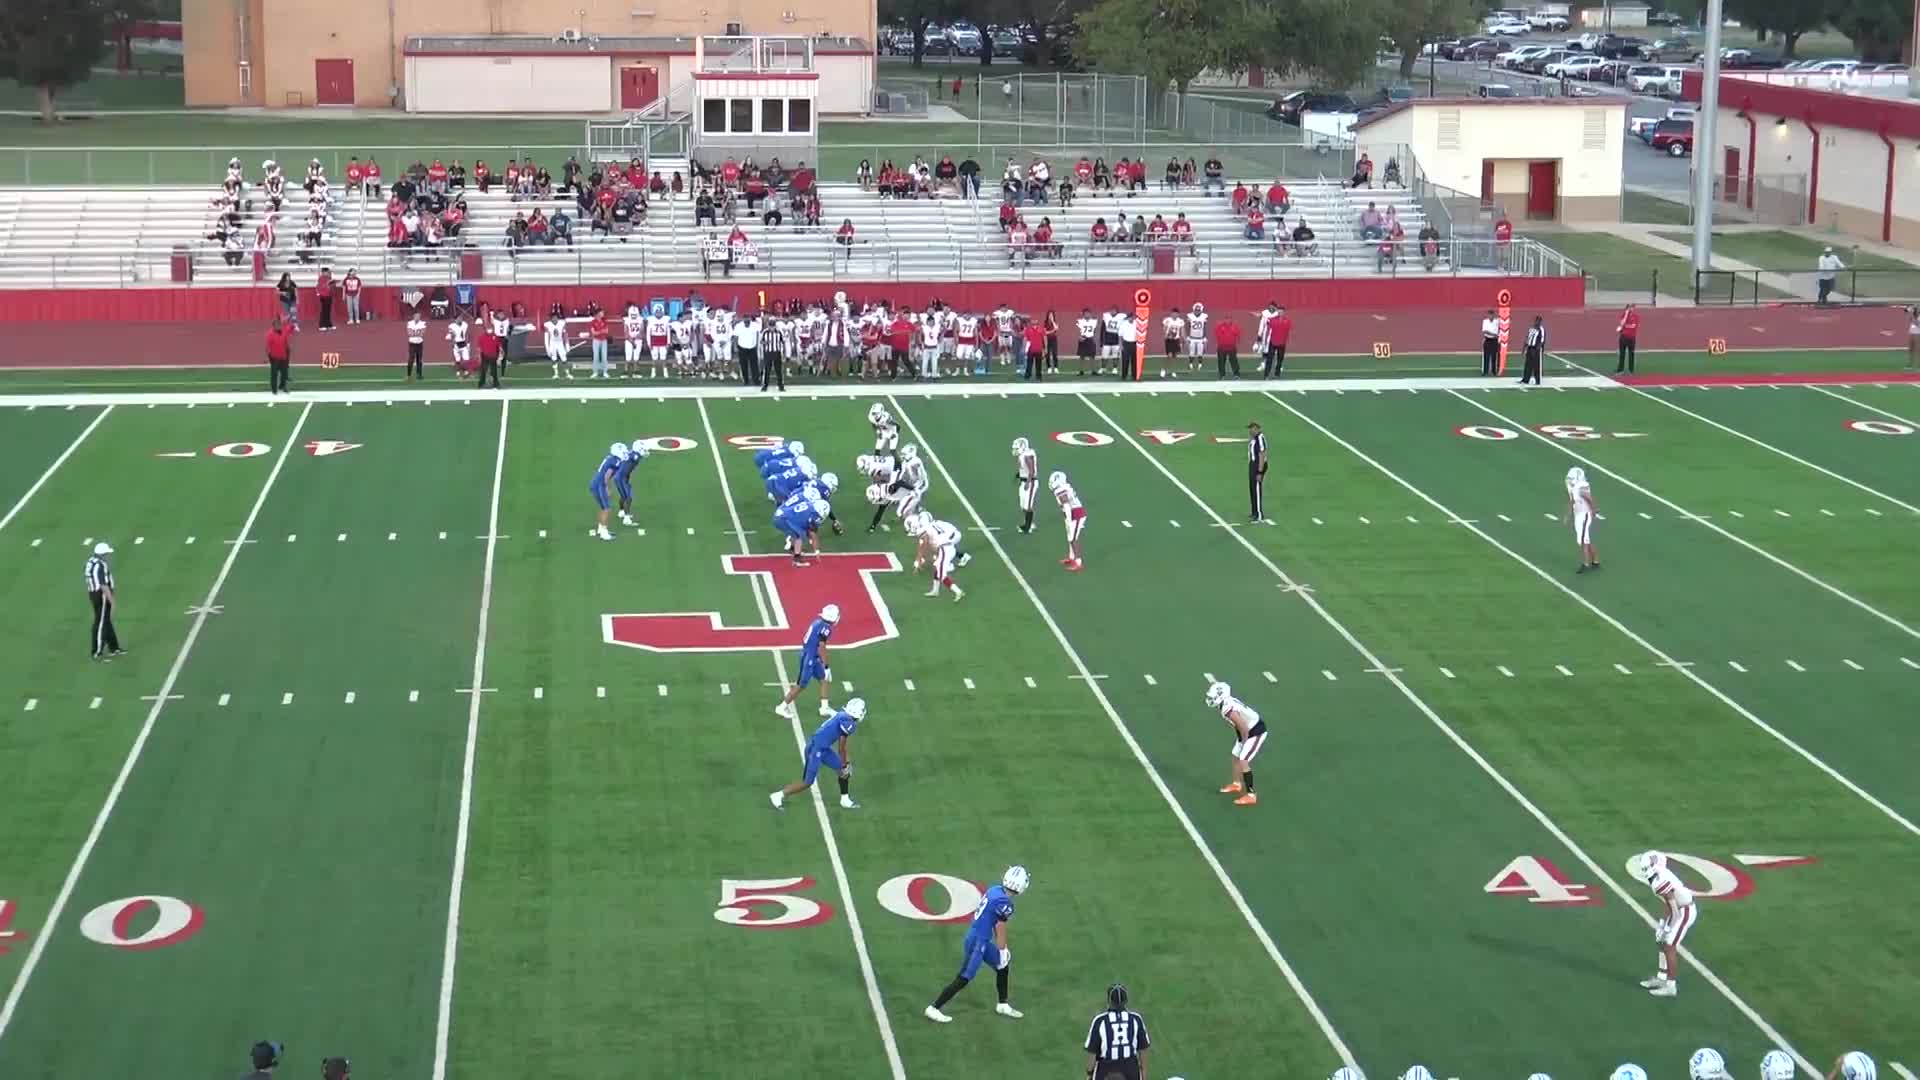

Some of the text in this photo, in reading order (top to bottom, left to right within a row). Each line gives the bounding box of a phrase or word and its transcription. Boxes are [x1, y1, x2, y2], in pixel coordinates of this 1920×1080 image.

[1375, 343, 1391, 357] 30
[1710, 340, 1725, 353] 20
[322, 353, 339, 368] 40
[602, 551, 904, 652] J
[1111, 1023, 1130, 1046] H
